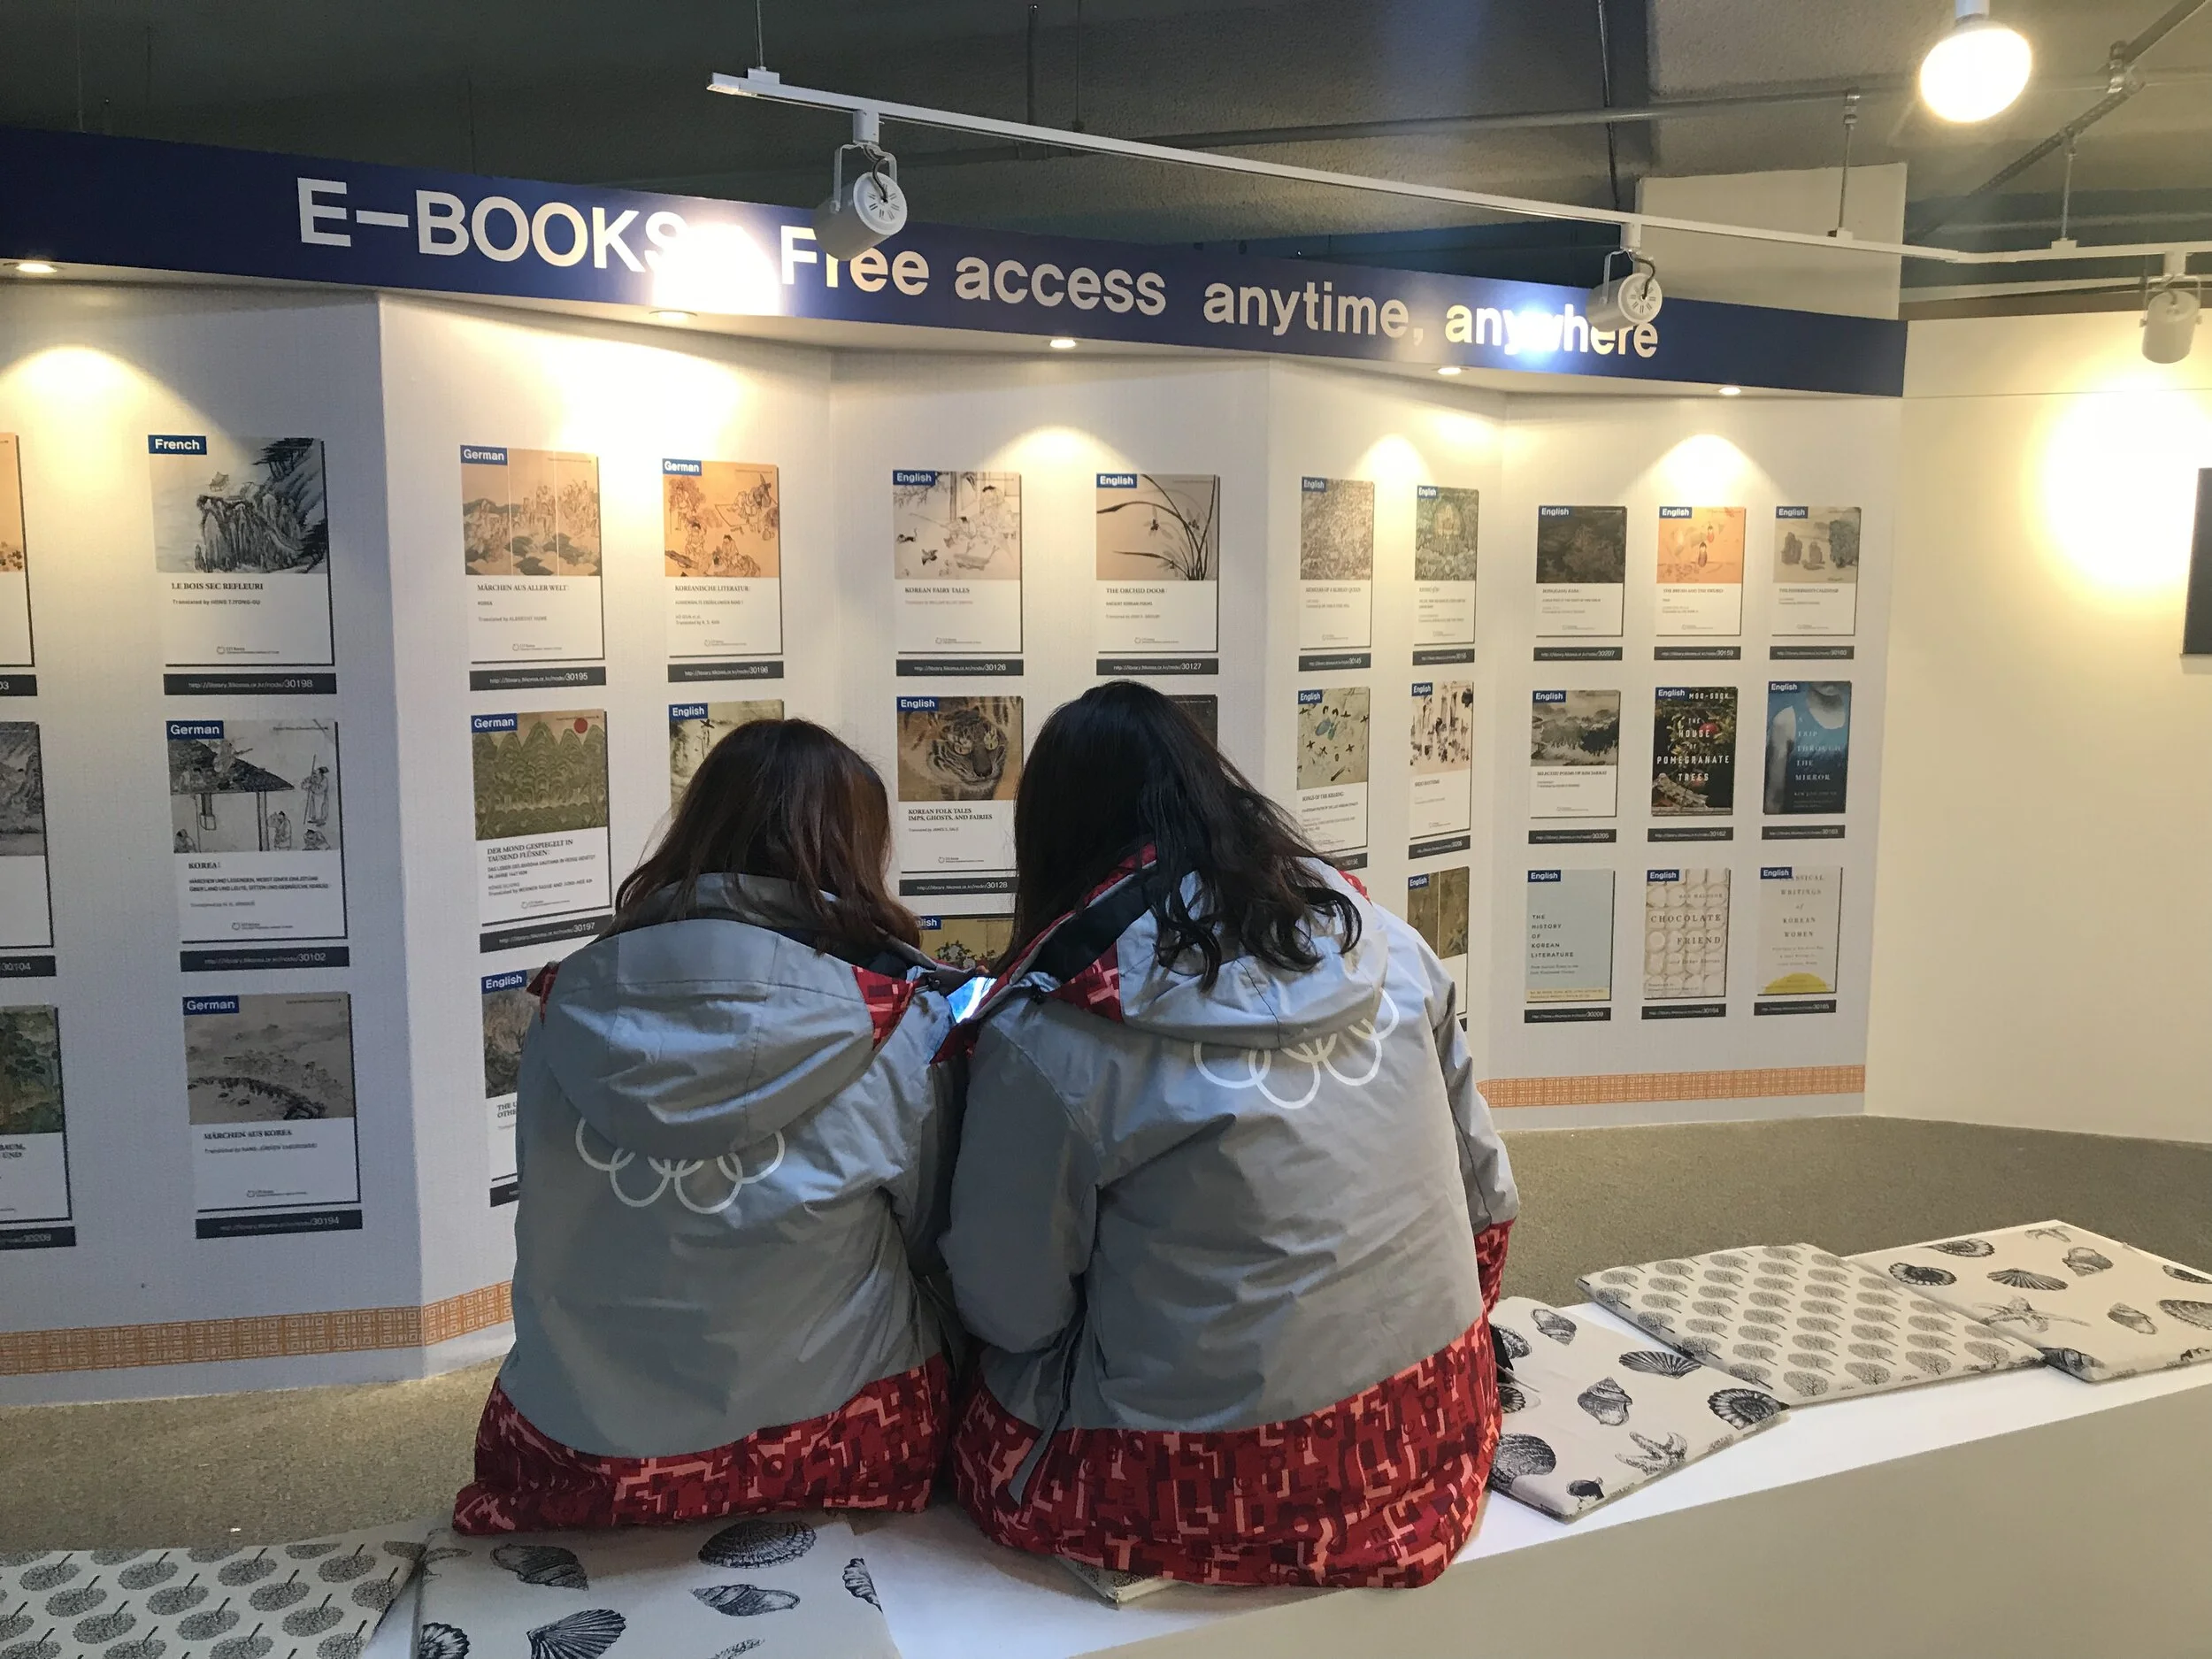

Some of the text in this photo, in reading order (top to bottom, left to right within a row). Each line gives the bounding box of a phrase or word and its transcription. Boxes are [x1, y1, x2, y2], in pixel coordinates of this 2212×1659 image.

[780, 225, 930, 296] Free
[955, 256, 1167, 316] access
[1203, 280, 1425, 346] anytime,
[1445, 303, 1659, 358] anyhere
[155, 439, 200, 450] French
[463, 449, 505, 461] German
[664, 461, 700, 472] German
[897, 472, 932, 484] English
[1100, 475, 1133, 487] English
[1303, 479, 1325, 490] English
[1418, 486, 1437, 497] English
[1541, 507, 1570, 517] English
[1662, 508, 1690, 518] English
[1778, 508, 1806, 518] English
[477, 583, 512, 592] MÄRCHEN
[1413, 684, 1432, 695] English
[1658, 688, 1686, 698] English
[1770, 683, 1798, 693] English
[1300, 692, 1321, 703] English
[1535, 692, 1563, 702] English
[900, 699, 935, 710] English
[672, 706, 705, 718] English
[474, 717, 515, 729] German
[171, 724, 220, 735] German
[1678, 729, 1710, 738] HOUSE
[1656, 755, 1730, 764] POMEGRANATE
[487, 847, 503, 856] DER
[503, 843, 525, 853] MOND
[526, 840, 564, 850] GESPIEGELT
[488, 853, 518, 863] TAUSEND
[1531, 872, 1558, 881] English
[1649, 872, 1677, 880] English
[1763, 869, 1789, 879] English
[1409, 876, 1428, 887] English
[1650, 914, 1721, 923] CHOCOLATE
[1678, 936, 1721, 946] FRIEND
[485, 974, 523, 988] English
[187, 1001, 235, 1011] German
